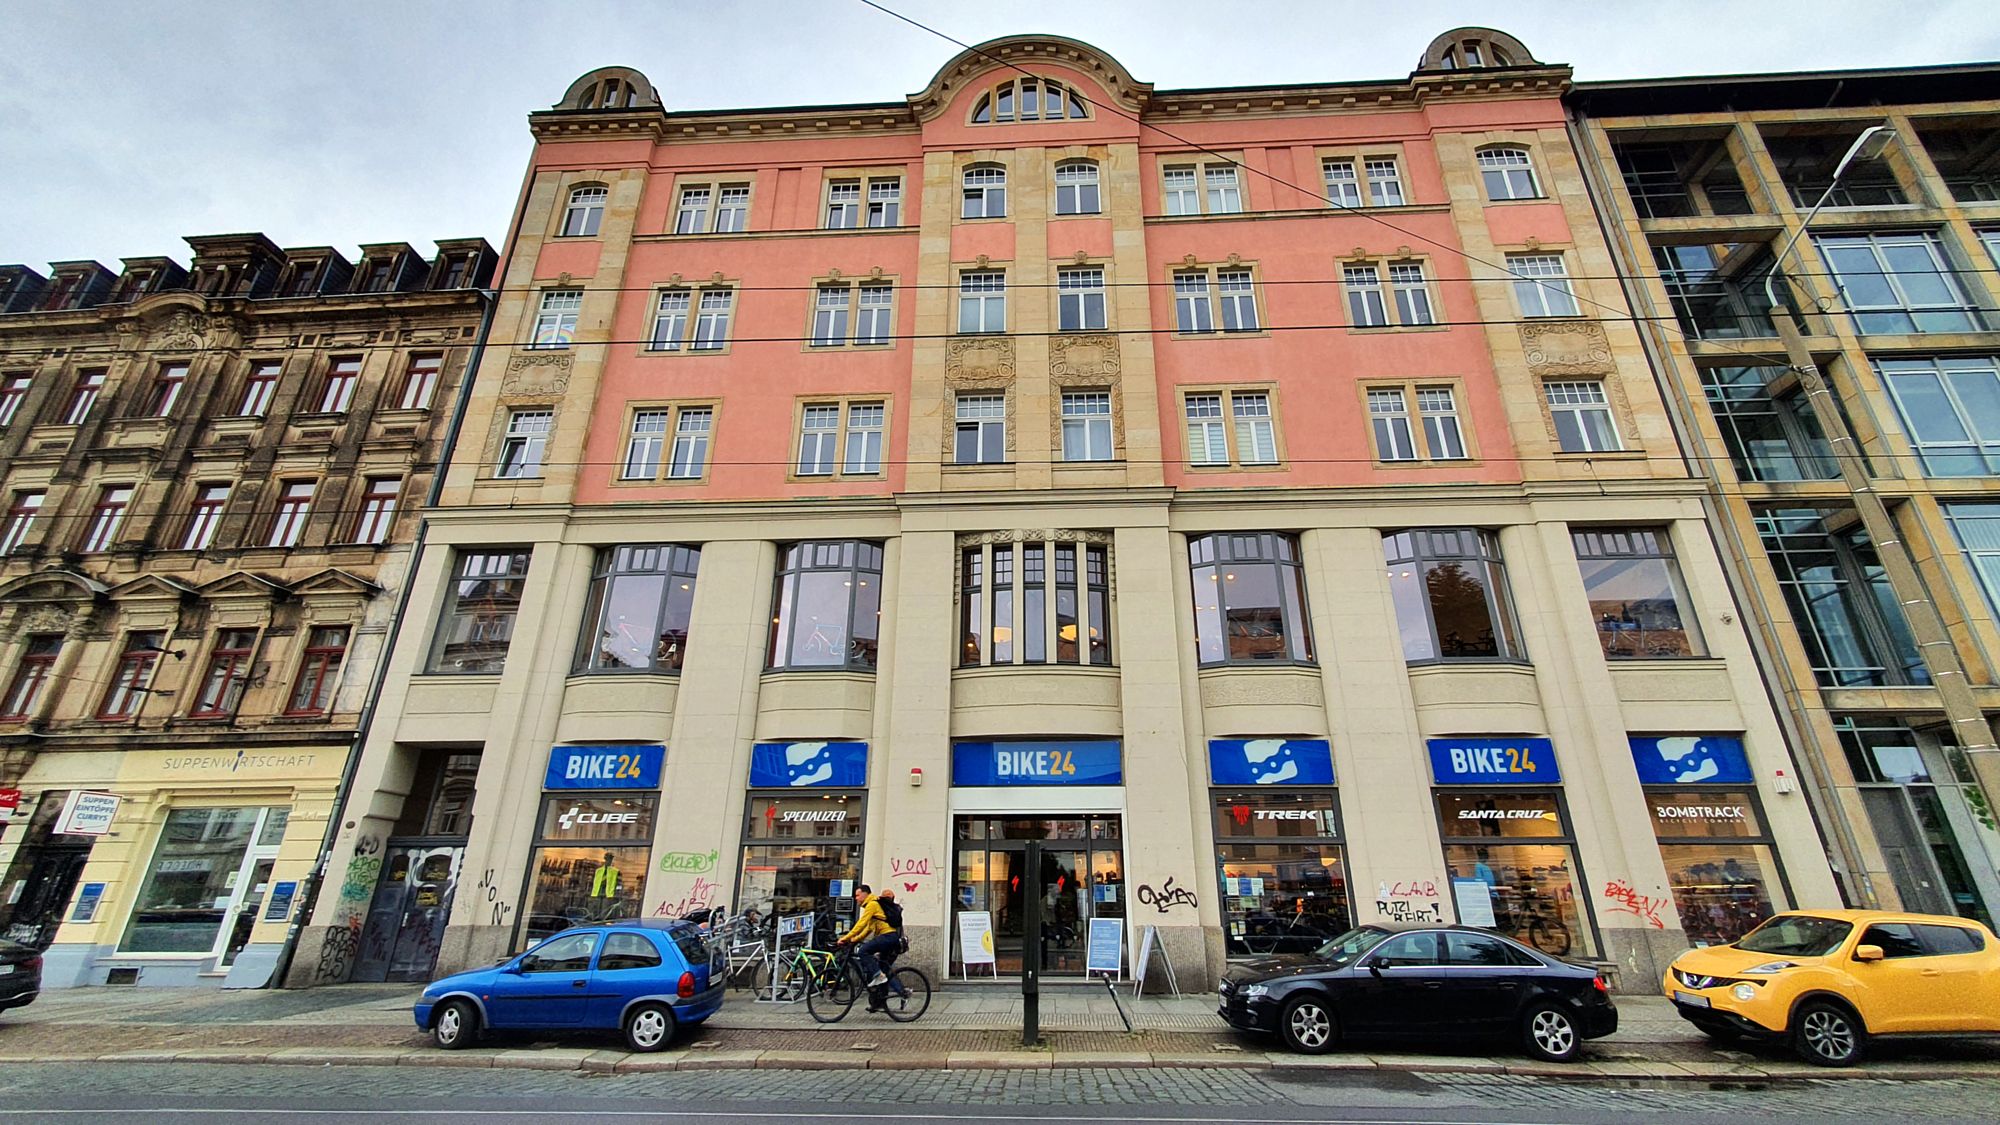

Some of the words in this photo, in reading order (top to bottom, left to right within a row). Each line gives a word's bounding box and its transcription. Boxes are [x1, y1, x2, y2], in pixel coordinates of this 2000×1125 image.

[163, 750, 315, 772] SUPPENWIRTSCHAFT
[565, 754, 641, 779] BIKE24
[998, 751, 1076, 776] BIKE24
[1450, 748, 1536, 773] BIKE24
[83, 796, 115, 804] SUPPEN
[76, 804, 115, 813] EINTÖPFE
[1458, 810, 1505, 819] SANTA
[1506, 810, 1544, 819] CRUZ
[1656, 806, 1744, 818] BOMBTRACK
[77, 813, 107, 821] CURRYS
[576, 813, 639, 824] CUBE
[780, 810, 847, 822] SPECIALIZED
[1254, 810, 1318, 820] TREK
[891, 857, 928, 874] VON
